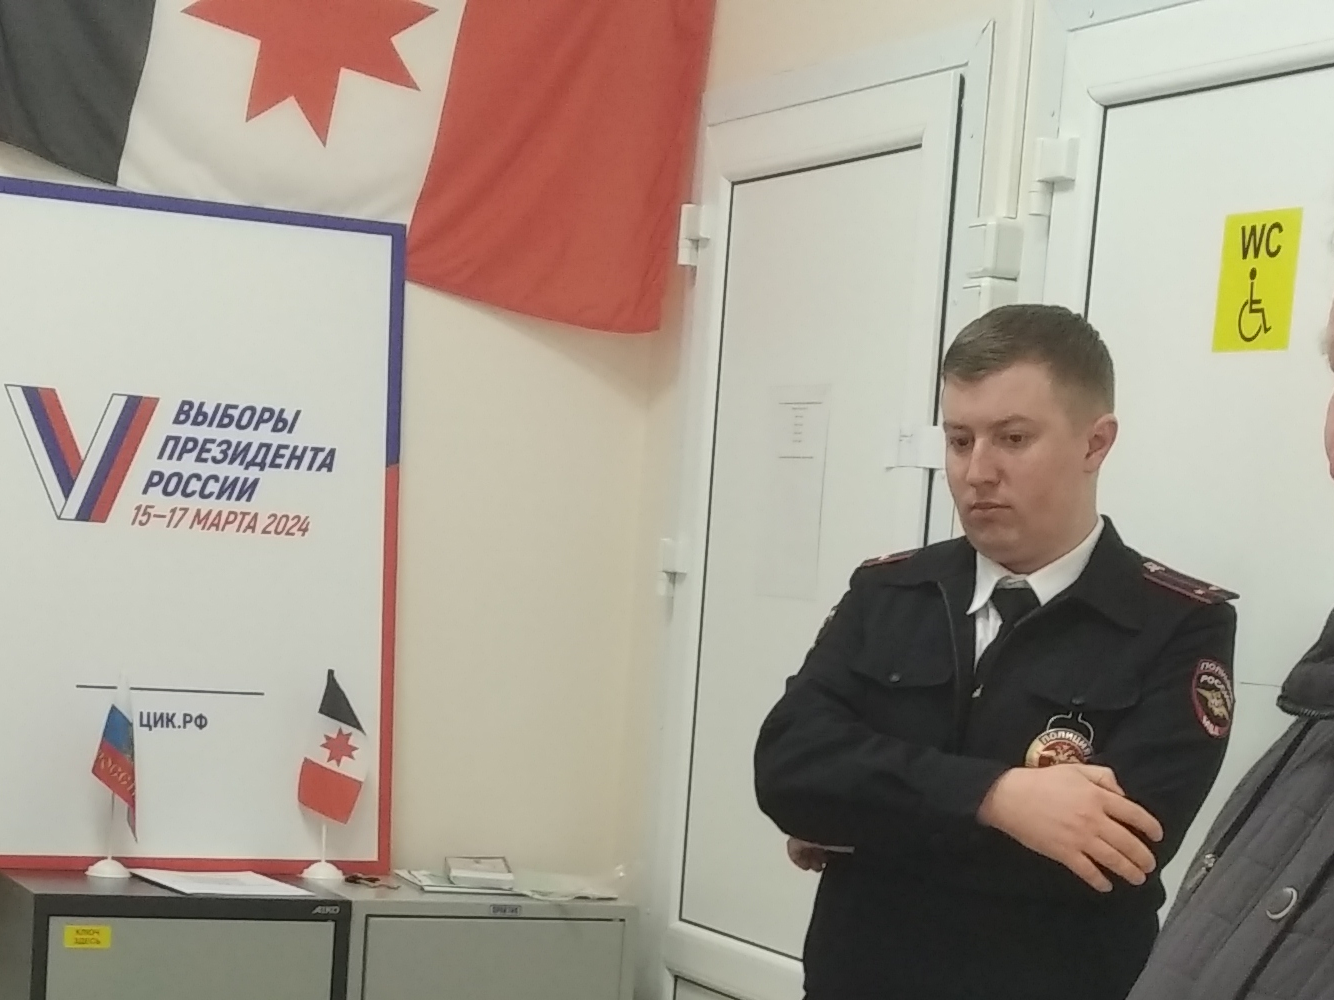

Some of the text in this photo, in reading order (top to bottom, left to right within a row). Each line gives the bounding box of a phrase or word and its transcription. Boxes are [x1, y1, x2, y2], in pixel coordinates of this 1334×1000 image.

[1241, 222, 1284, 260] WC
[172, 399, 302, 434] ВЫБОРЫ
[156, 434, 337, 473] ПРЕЗИДЕНТА
[141, 470, 261, 503] РОССИИ
[190, 508, 258, 534] МАРТА
[261, 513, 311, 537] 2024
[138, 710, 209, 731] ЦИК.РФ
[1040, 731, 1092, 757] ПОЛИЦИЯ
